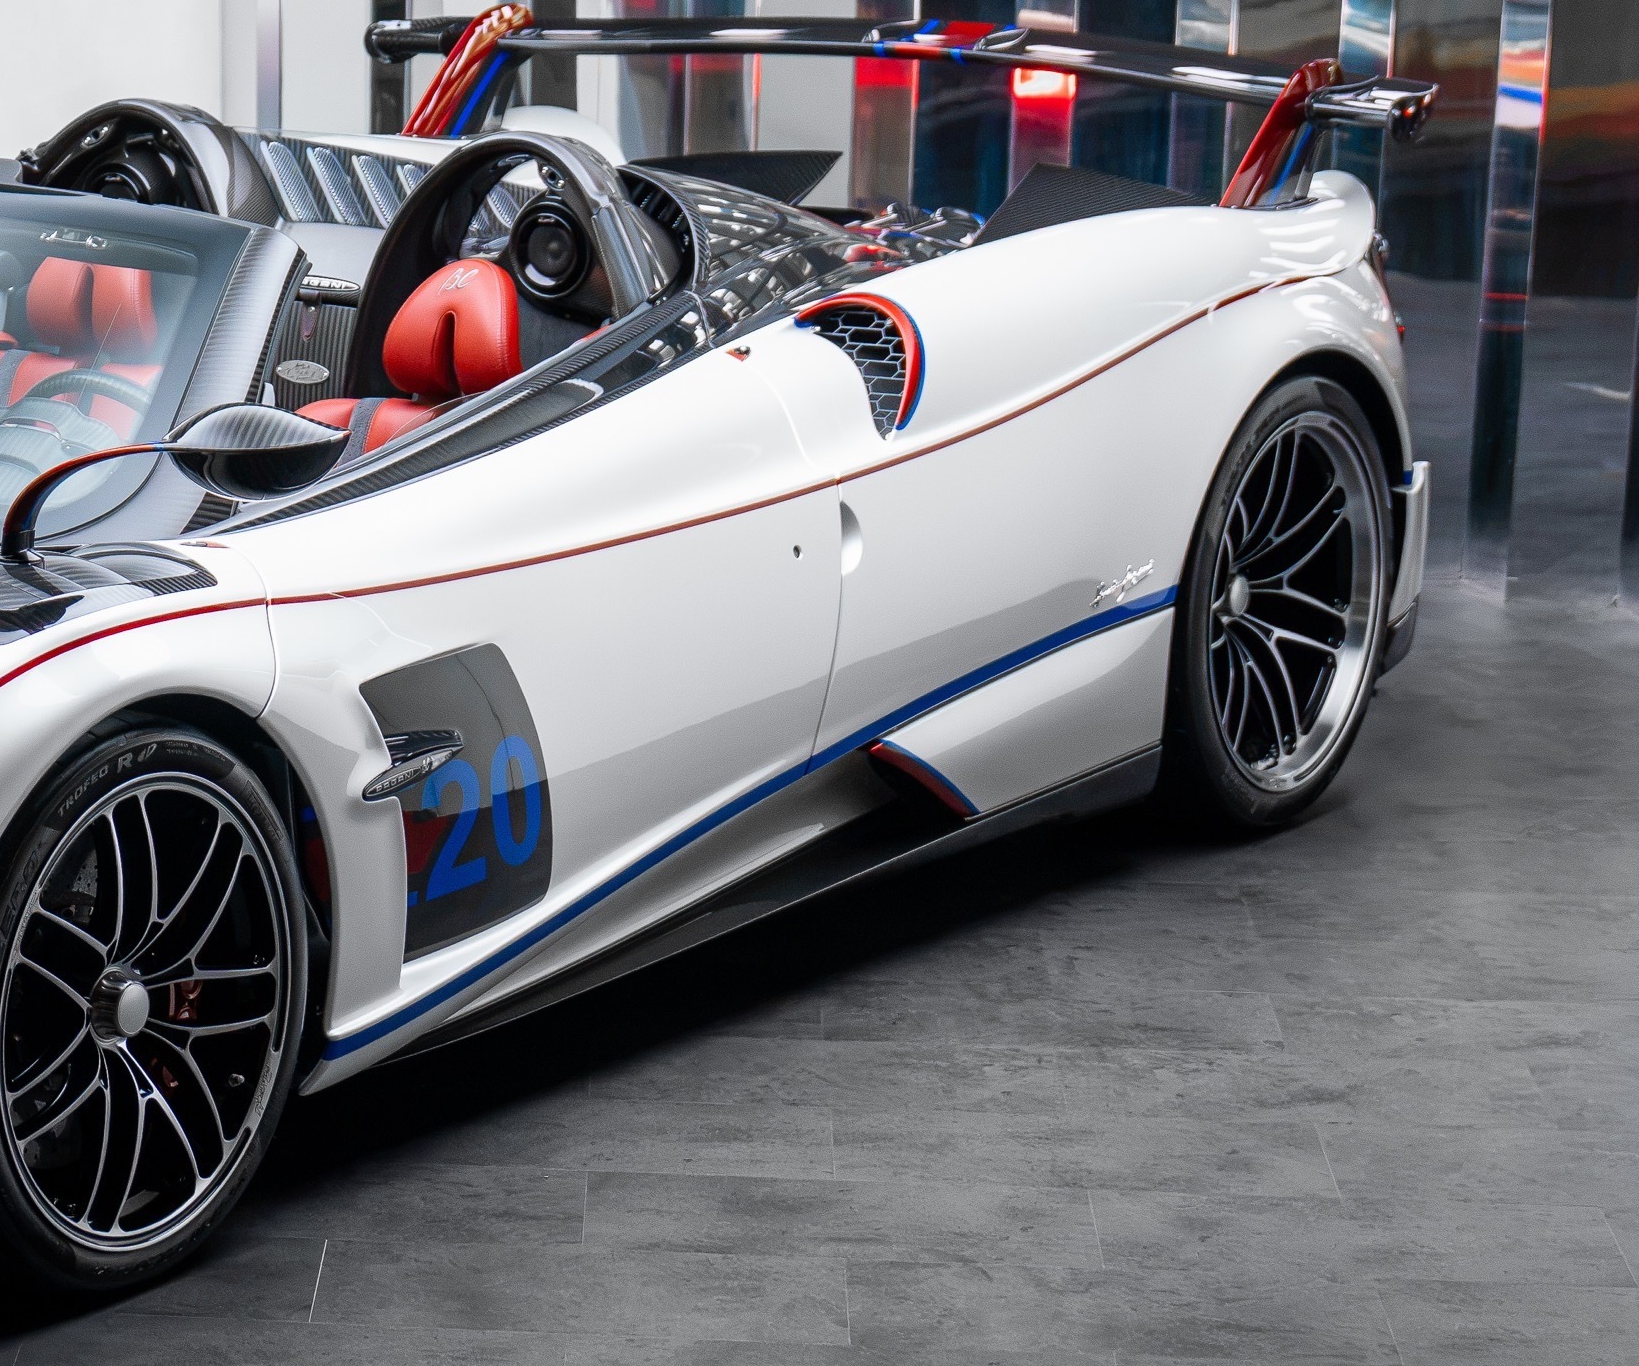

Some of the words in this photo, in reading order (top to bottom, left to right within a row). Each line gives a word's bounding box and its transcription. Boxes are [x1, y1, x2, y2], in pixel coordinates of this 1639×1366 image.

[56, 764, 109, 818] TROFEO
[375, 769, 415, 793] PAGANI
[420, 735, 542, 902] 20
